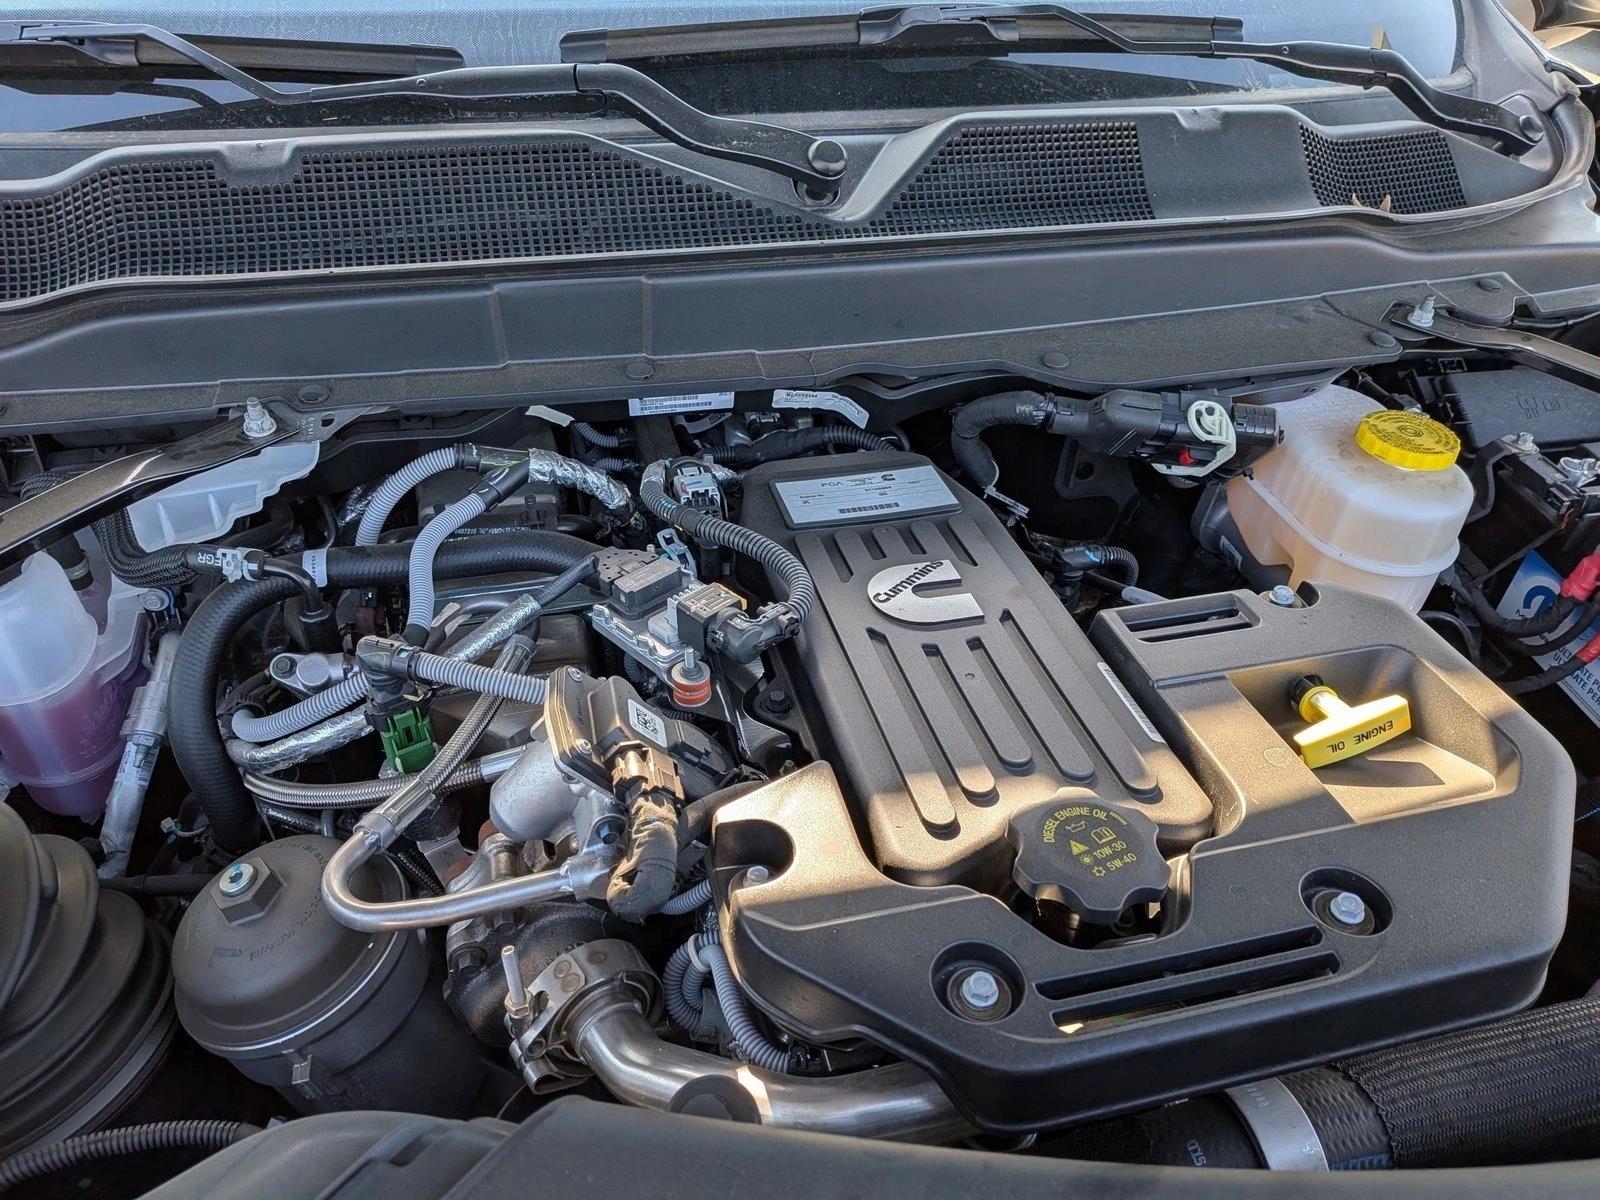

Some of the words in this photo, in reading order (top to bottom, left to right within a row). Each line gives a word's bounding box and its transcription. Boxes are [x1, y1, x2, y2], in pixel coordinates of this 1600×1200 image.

[197, 552, 222, 567] EGR
[872, 560, 944, 604] Cummins
[1353, 720, 1394, 745] ENGINE
[1326, 741, 1346, 754] OIL
[1043, 818, 1061, 843] DIESEL
[1054, 806, 1091, 821] ENGINE
[1092, 808, 1108, 821] OIL
[1093, 840, 1127, 860] 10W-30
[1106, 852, 1137, 871] 5W-40
